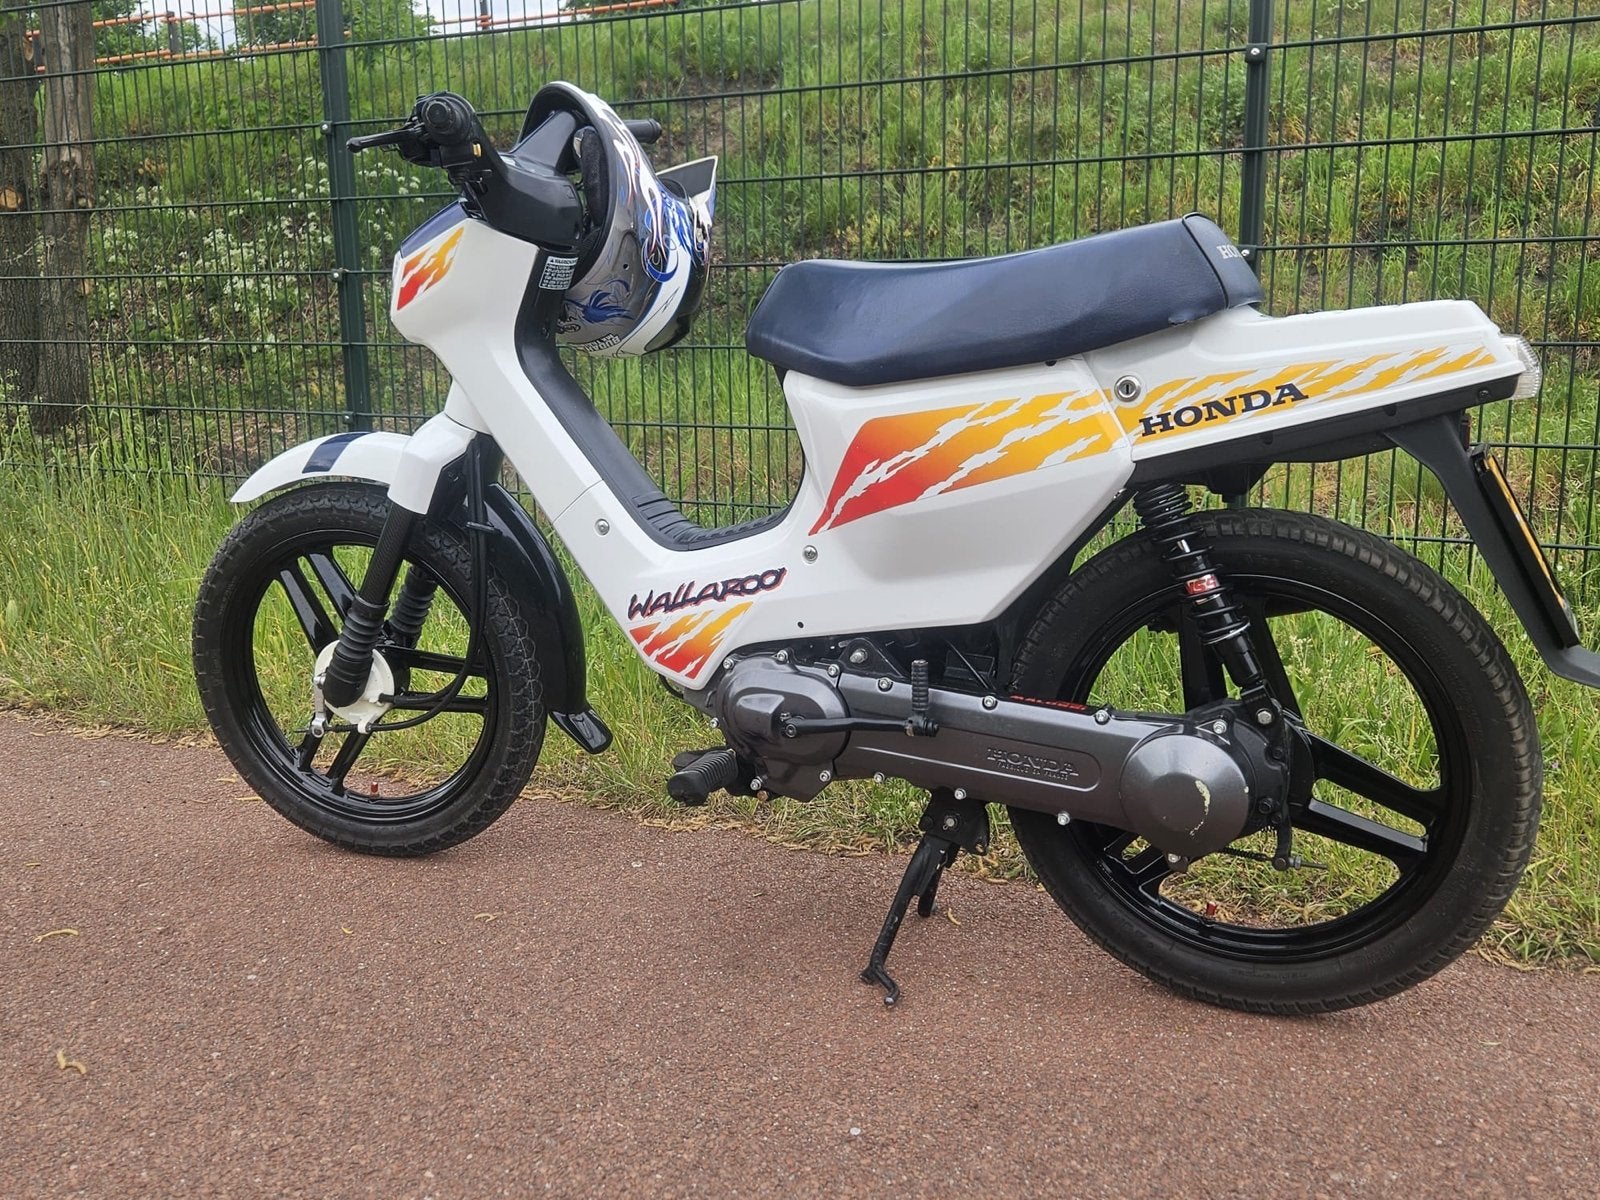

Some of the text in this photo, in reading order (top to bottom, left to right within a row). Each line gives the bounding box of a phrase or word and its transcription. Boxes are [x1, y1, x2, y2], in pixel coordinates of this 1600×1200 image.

[1138, 382, 1309, 437] HONDA
[627, 566, 788, 621] WALLAROO
[986, 748, 1079, 776] HONDA
